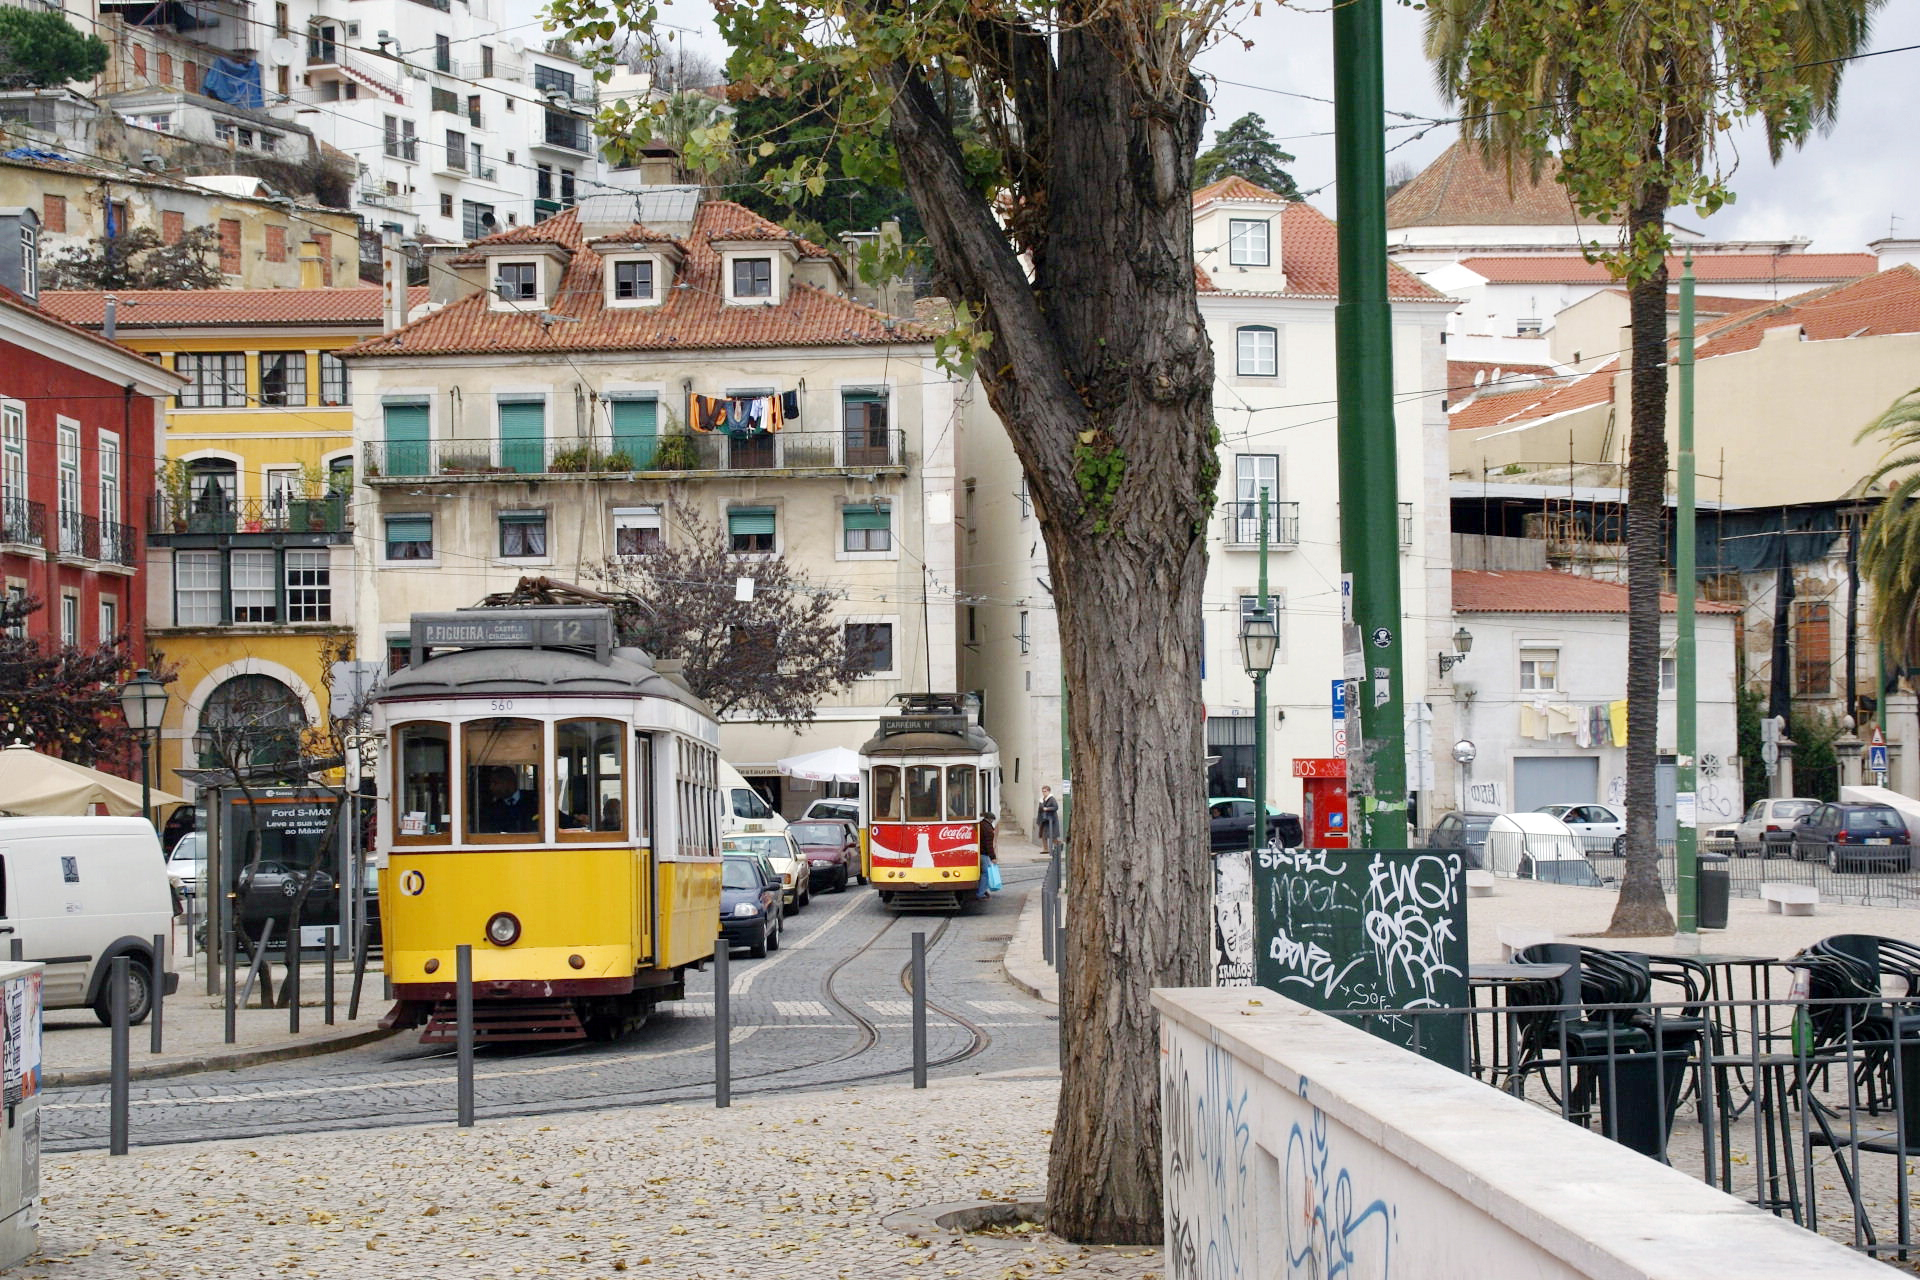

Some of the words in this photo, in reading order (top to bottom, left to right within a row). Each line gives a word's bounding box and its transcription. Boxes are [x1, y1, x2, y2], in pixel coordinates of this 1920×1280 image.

[553, 620, 582, 641] 12
[491, 700, 513, 711] 560
[886, 719, 921, 729] CARREIRA
[298, 827, 326, 835] Máxim
[938, 825, 974, 840] Coca-Cola
